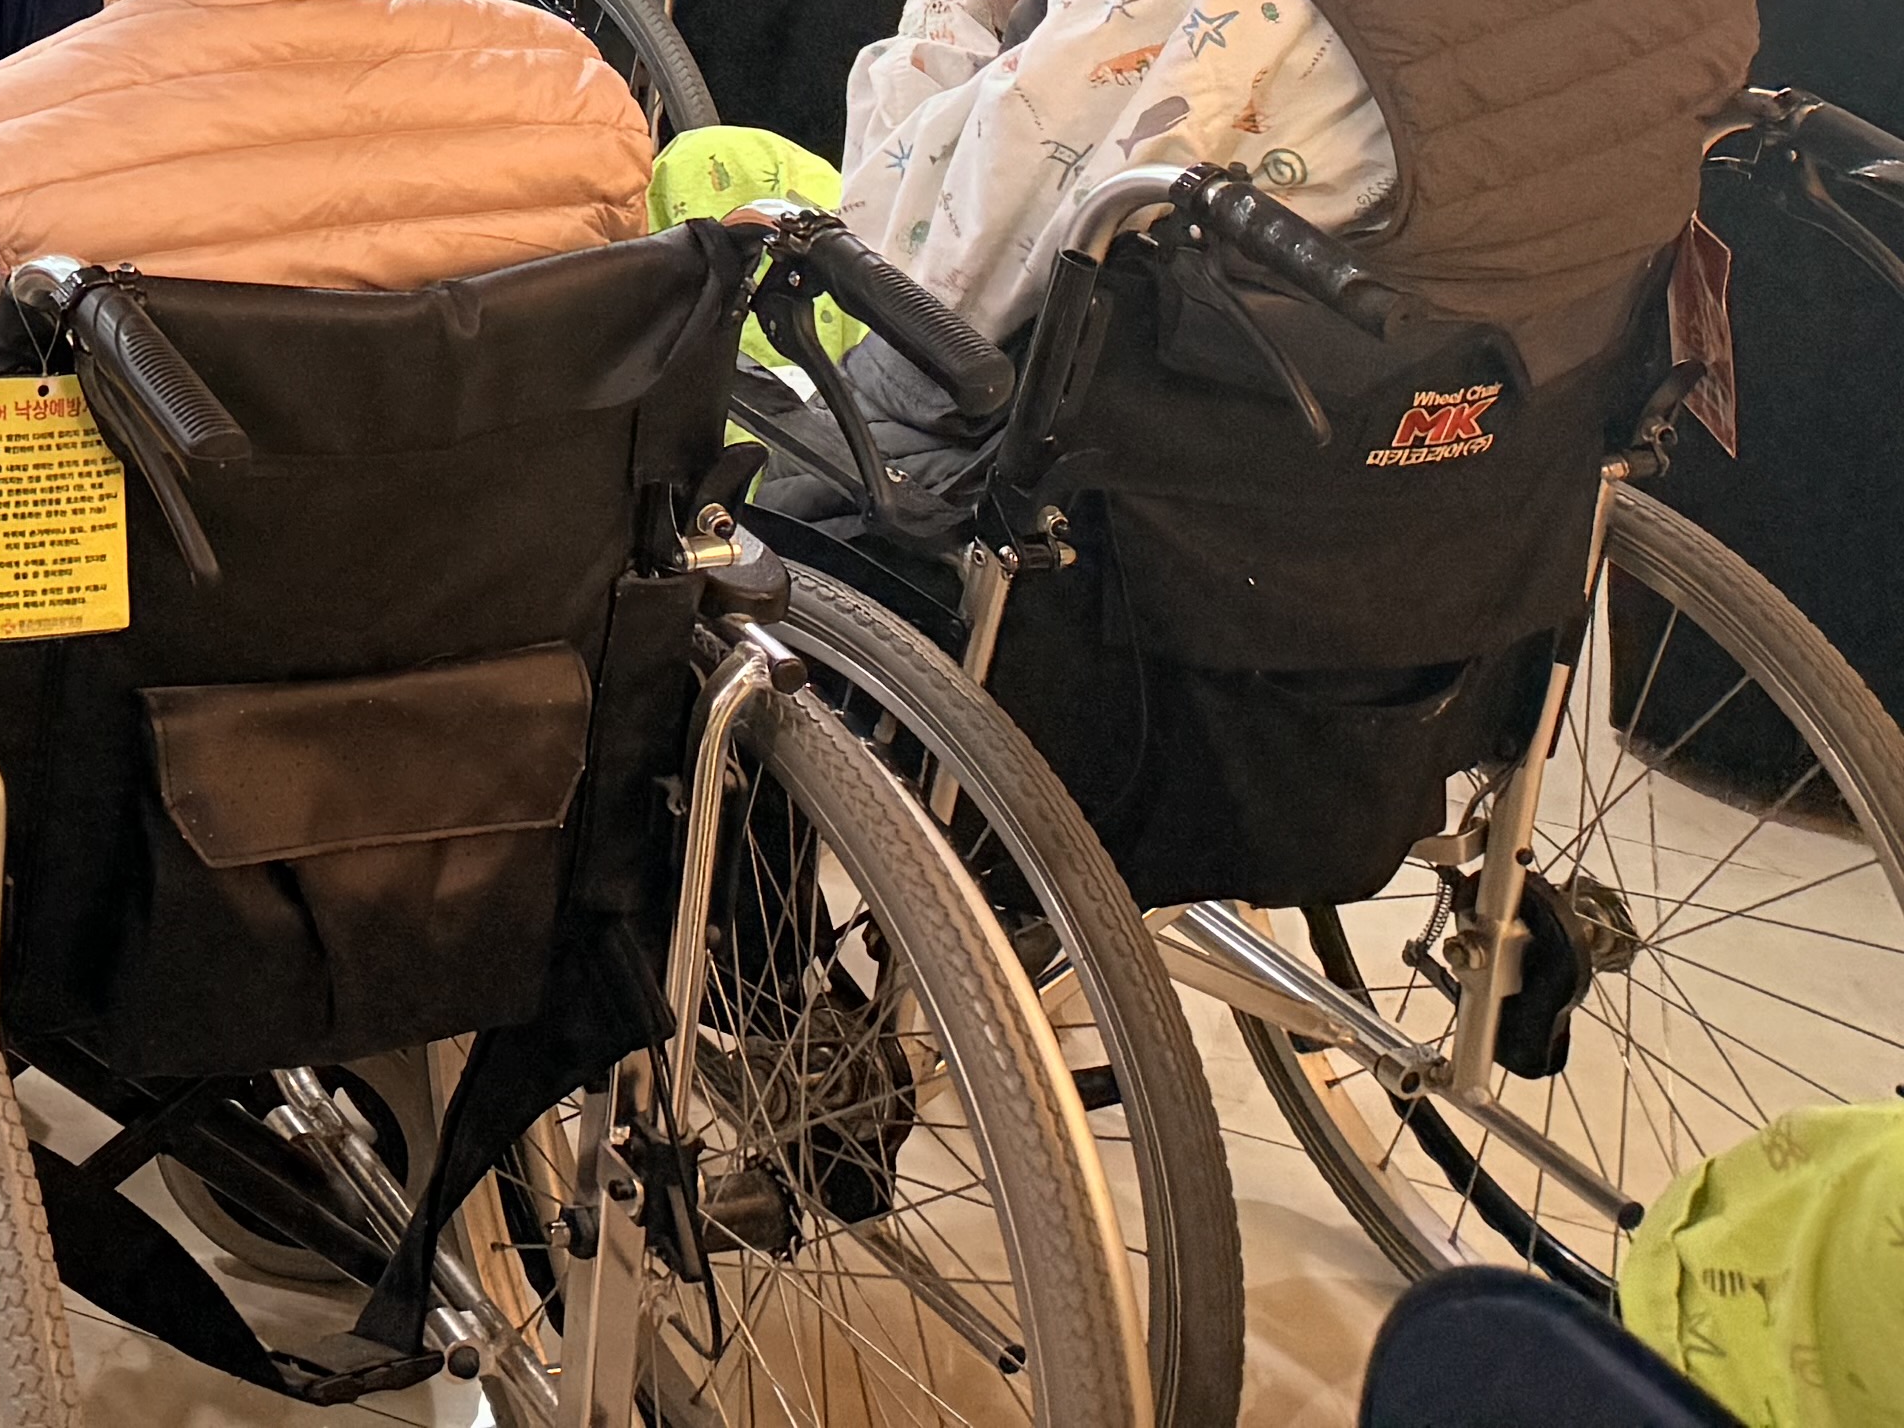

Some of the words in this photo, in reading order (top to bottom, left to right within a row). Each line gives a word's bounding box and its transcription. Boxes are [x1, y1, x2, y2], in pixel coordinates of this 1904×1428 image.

[1412, 387, 1465, 407] Wheel
[1465, 380, 1505, 401] Chair
[14, 396, 89, 422] 낙상예방
[1391, 395, 1499, 448] MK
